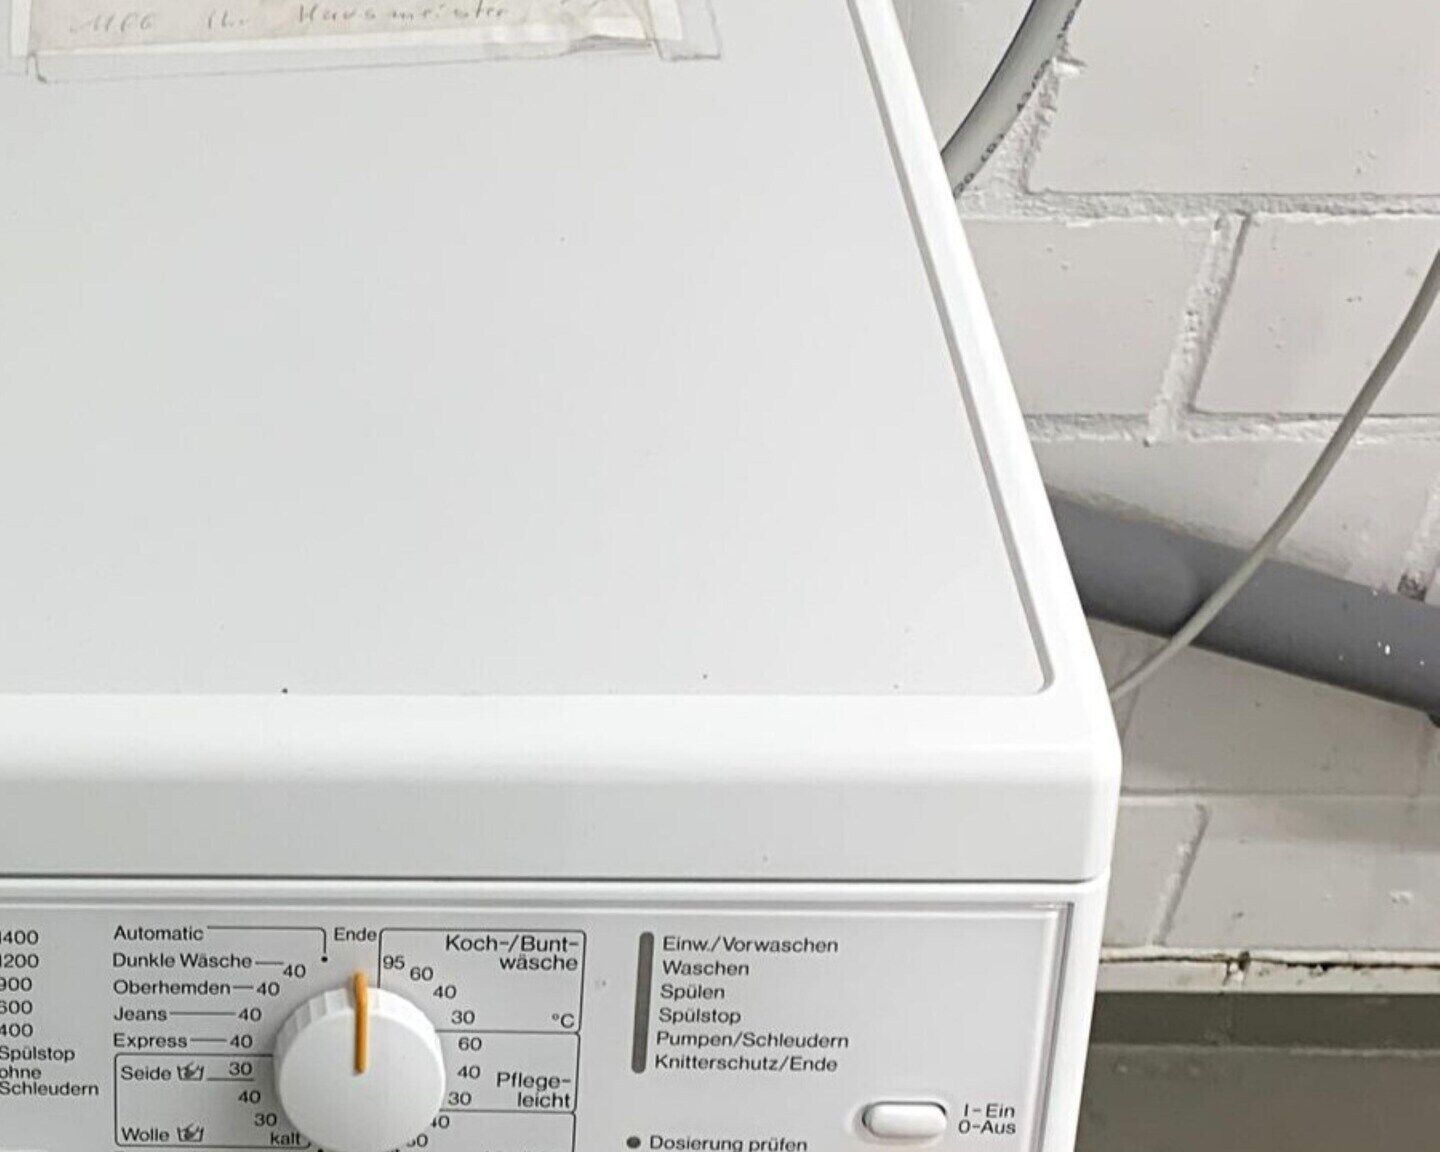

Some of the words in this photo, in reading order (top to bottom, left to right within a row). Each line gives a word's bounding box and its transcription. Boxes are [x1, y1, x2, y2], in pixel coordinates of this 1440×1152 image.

[113, 926, 204, 942] Automatic
[333, 926, 378, 943] Ende
[445, 933, 579, 953] Koch-/Bunt-
[662, 936, 839, 955] Einw./Vorwaschen
[112, 952, 175, 969] Dunkle
[179, 952, 253, 969] Wäsche
[282, 963, 306, 979] 40
[382, 955, 406, 971] 95
[499, 954, 578, 972] wäsche
[662, 960, 750, 976] Waschen
[409, 966, 434, 982] 60
[112, 979, 232, 996] Oberhemden
[256, 981, 281, 997] 40
[432, 984, 457, 1000] 40
[660, 983, 726, 1002] Spülen
[113, 1006, 168, 1022] Jeans
[237, 1007, 262, 1022] 40
[451, 1010, 476, 1025] 30
[551, 1012, 575, 1030] °C
[659, 1007, 742, 1026] Spülstop
[113, 1032, 188, 1051] Express
[229, 1033, 253, 1048] 40
[458, 1036, 482, 1052] 60
[656, 1030, 850, 1050] Pumpen/Schleudern
[120, 1065, 172, 1082] Seide
[228, 1061, 253, 1077] 30
[456, 1064, 481, 1080] 40
[654, 1054, 838, 1073] Knitterschutz/Ende
[496, 1071, 572, 1091] Pflege-
[237, 1089, 261, 1104] 40
[447, 1091, 472, 1107] 30
[517, 1091, 571, 1109] leicht
[253, 1112, 278, 1127] 30
[121, 1126, 170, 1142] Wolle
[270, 1130, 301, 1146] kalt
